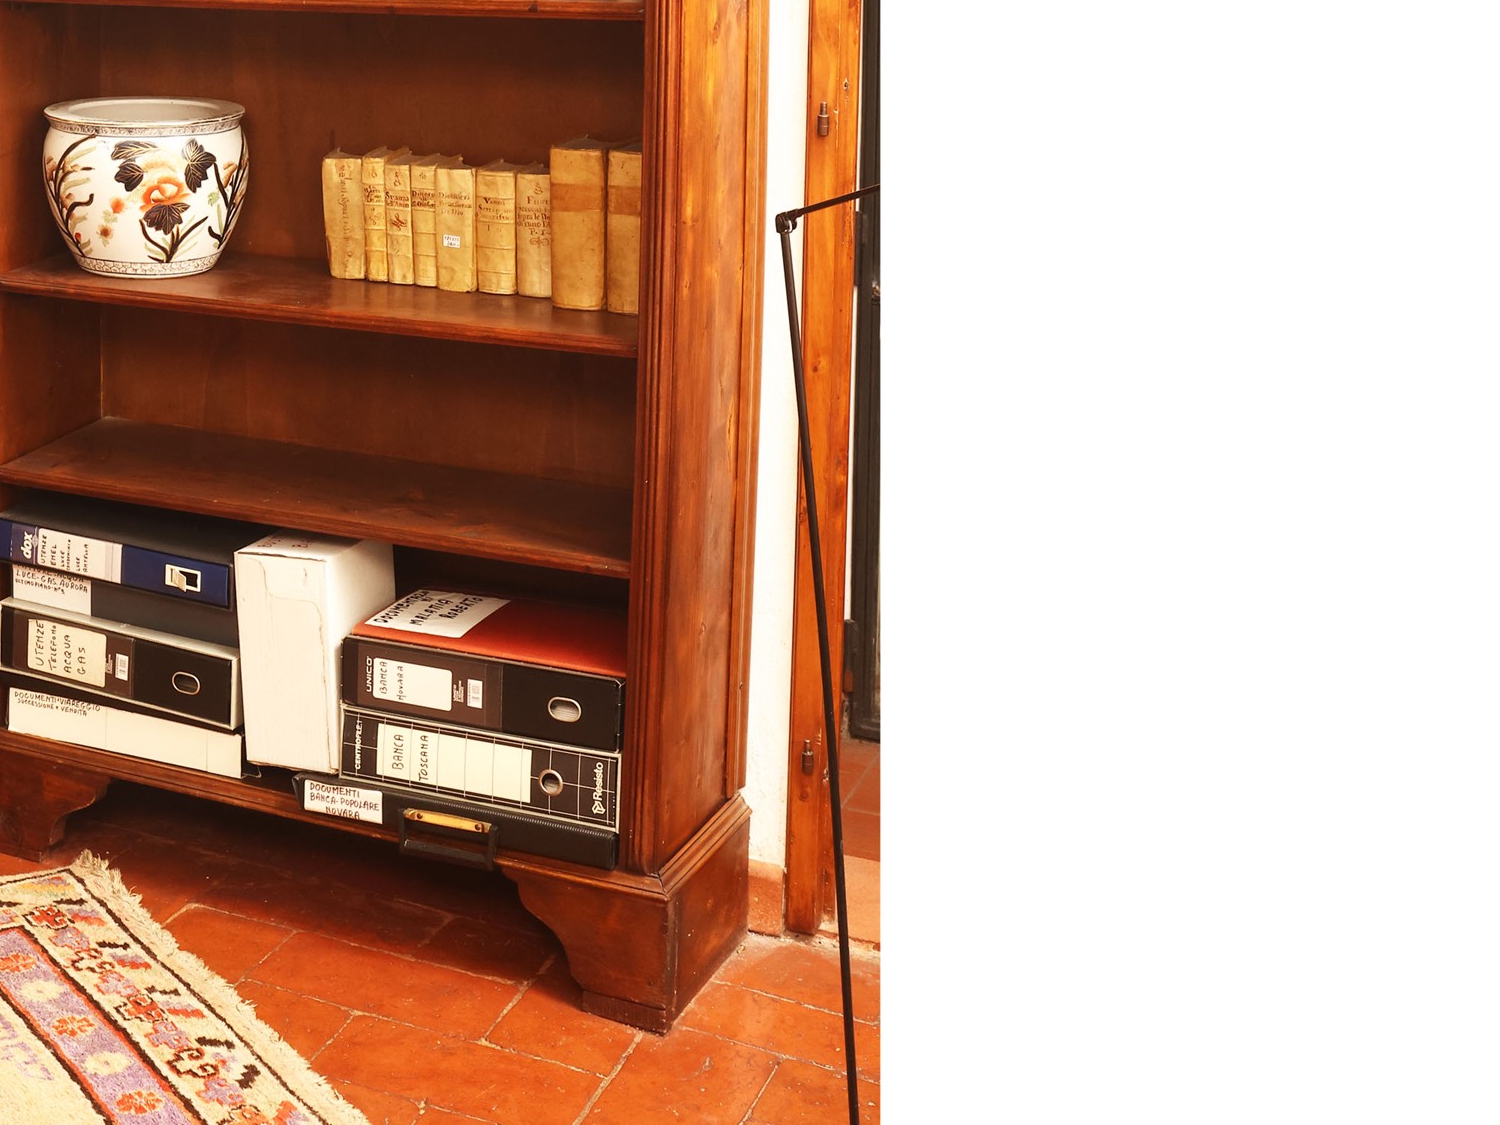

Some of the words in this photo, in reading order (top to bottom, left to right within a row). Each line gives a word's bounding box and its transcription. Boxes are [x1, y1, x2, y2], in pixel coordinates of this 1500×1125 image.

[20, 531, 33, 559] dox
[59, 579, 88, 594] AURORA
[35, 620, 44, 666] UTENZE
[48, 625, 57, 671] TELEFONO
[63, 634, 72, 673] ACQUA
[77, 647, 86, 675] GAS
[379, 661, 388, 695] BANCA
[17, 699, 54, 709] SUCCESSIONE
[61, 706, 87, 716] VENDITA
[392, 734, 404, 770] BANCA
[418, 735, 429, 781] TOSCANA
[310, 782, 360, 798] DOCUMENTI
[593, 761, 604, 802] Resisto
[325, 806, 360, 820] NOVARA
